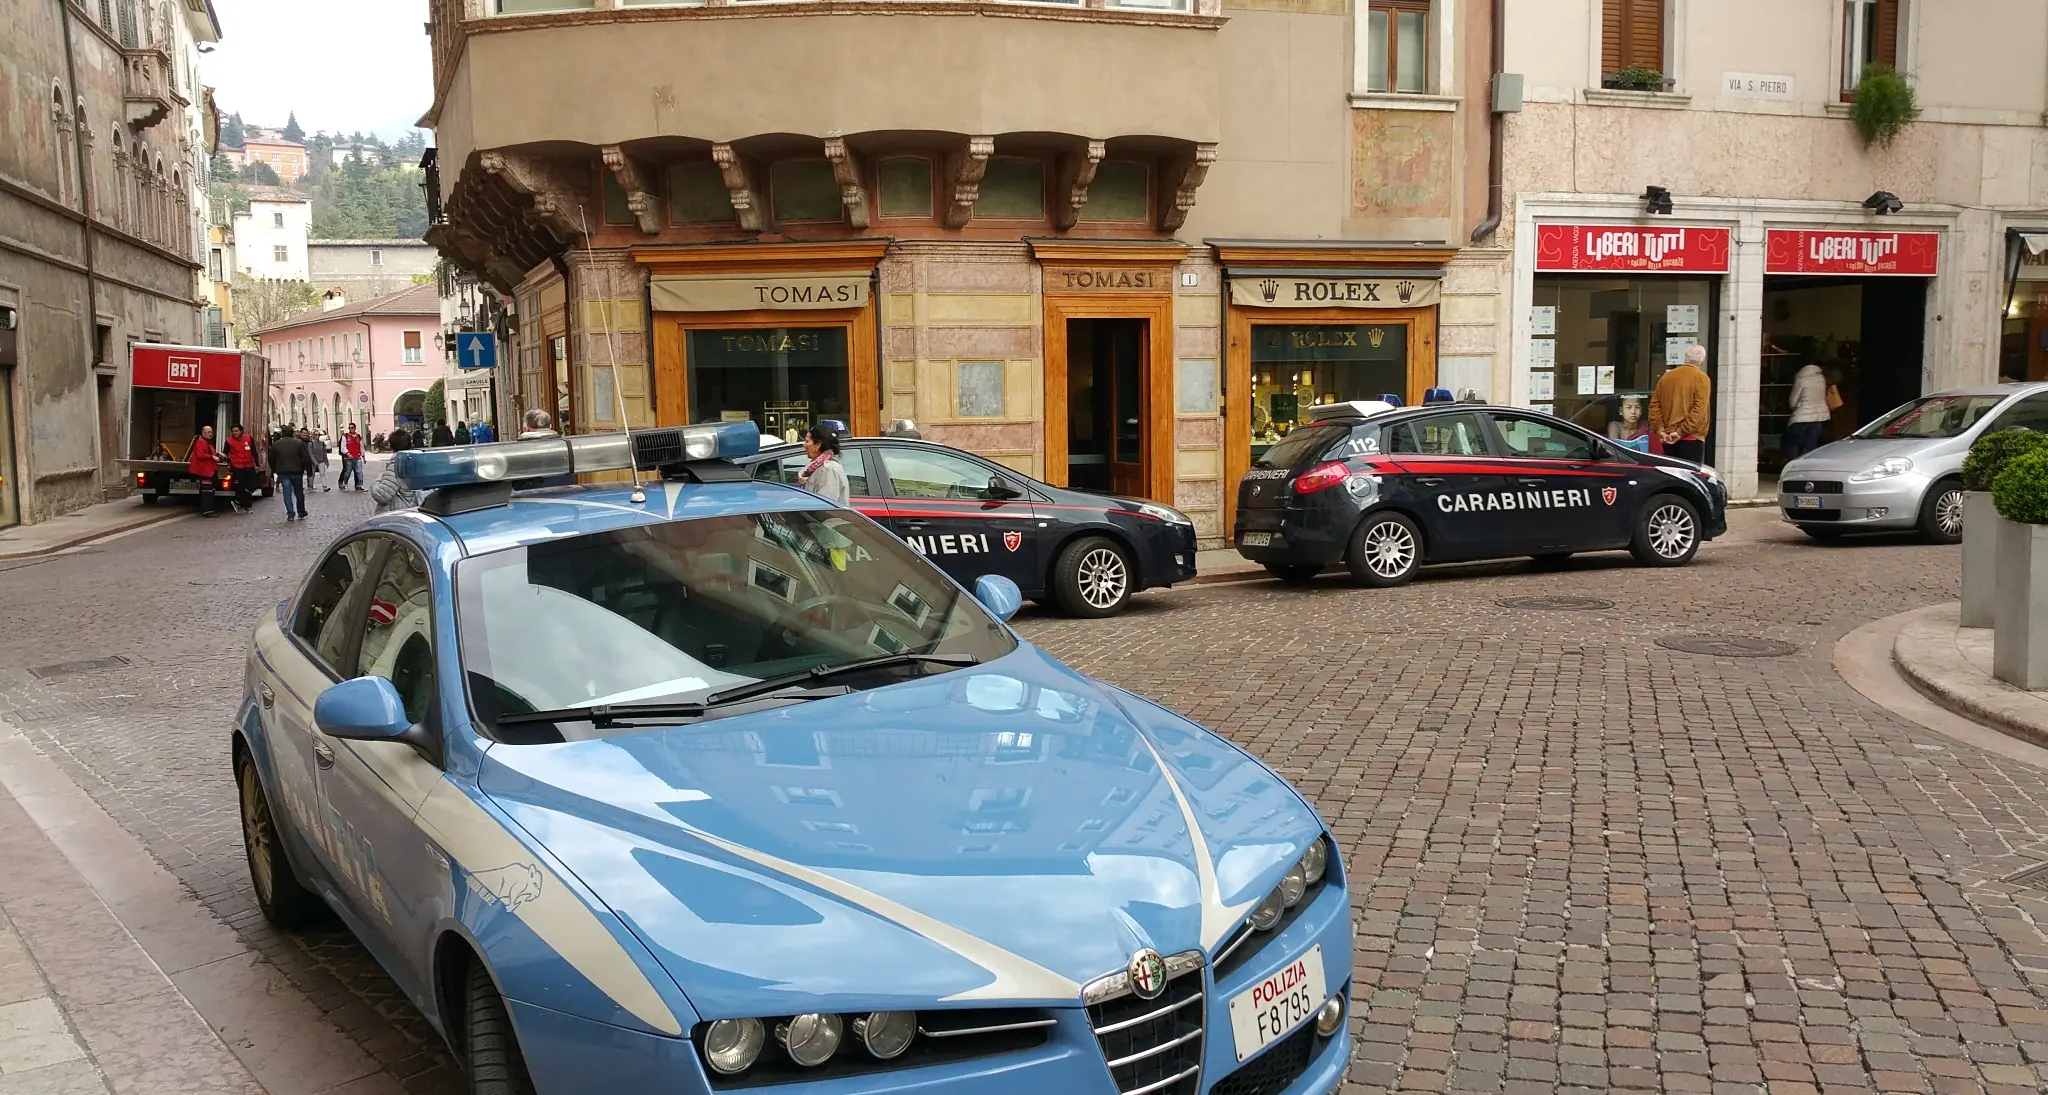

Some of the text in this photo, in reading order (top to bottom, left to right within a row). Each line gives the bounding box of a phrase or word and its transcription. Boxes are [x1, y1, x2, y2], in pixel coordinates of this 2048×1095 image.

[1729, 79, 1787, 94] VIA S. PIETRO
[1586, 229, 1686, 262] LIBERI TUTTI
[1810, 233, 1898, 265] LIBERI TUTTI
[1062, 271, 1155, 288] TOMASI
[754, 284, 859, 303] TOMASI
[1294, 282, 1381, 301] ROLEX
[722, 334, 820, 352] TOMASI
[1291, 331, 1358, 348] ROLEX
[170, 362, 199, 379] BRT
[1348, 437, 1380, 453] 112
[1437, 488, 1592, 513] CARABINIERI
[1252, 960, 1308, 1010] POLIZIA
[1257, 983, 1311, 1045] F8795
